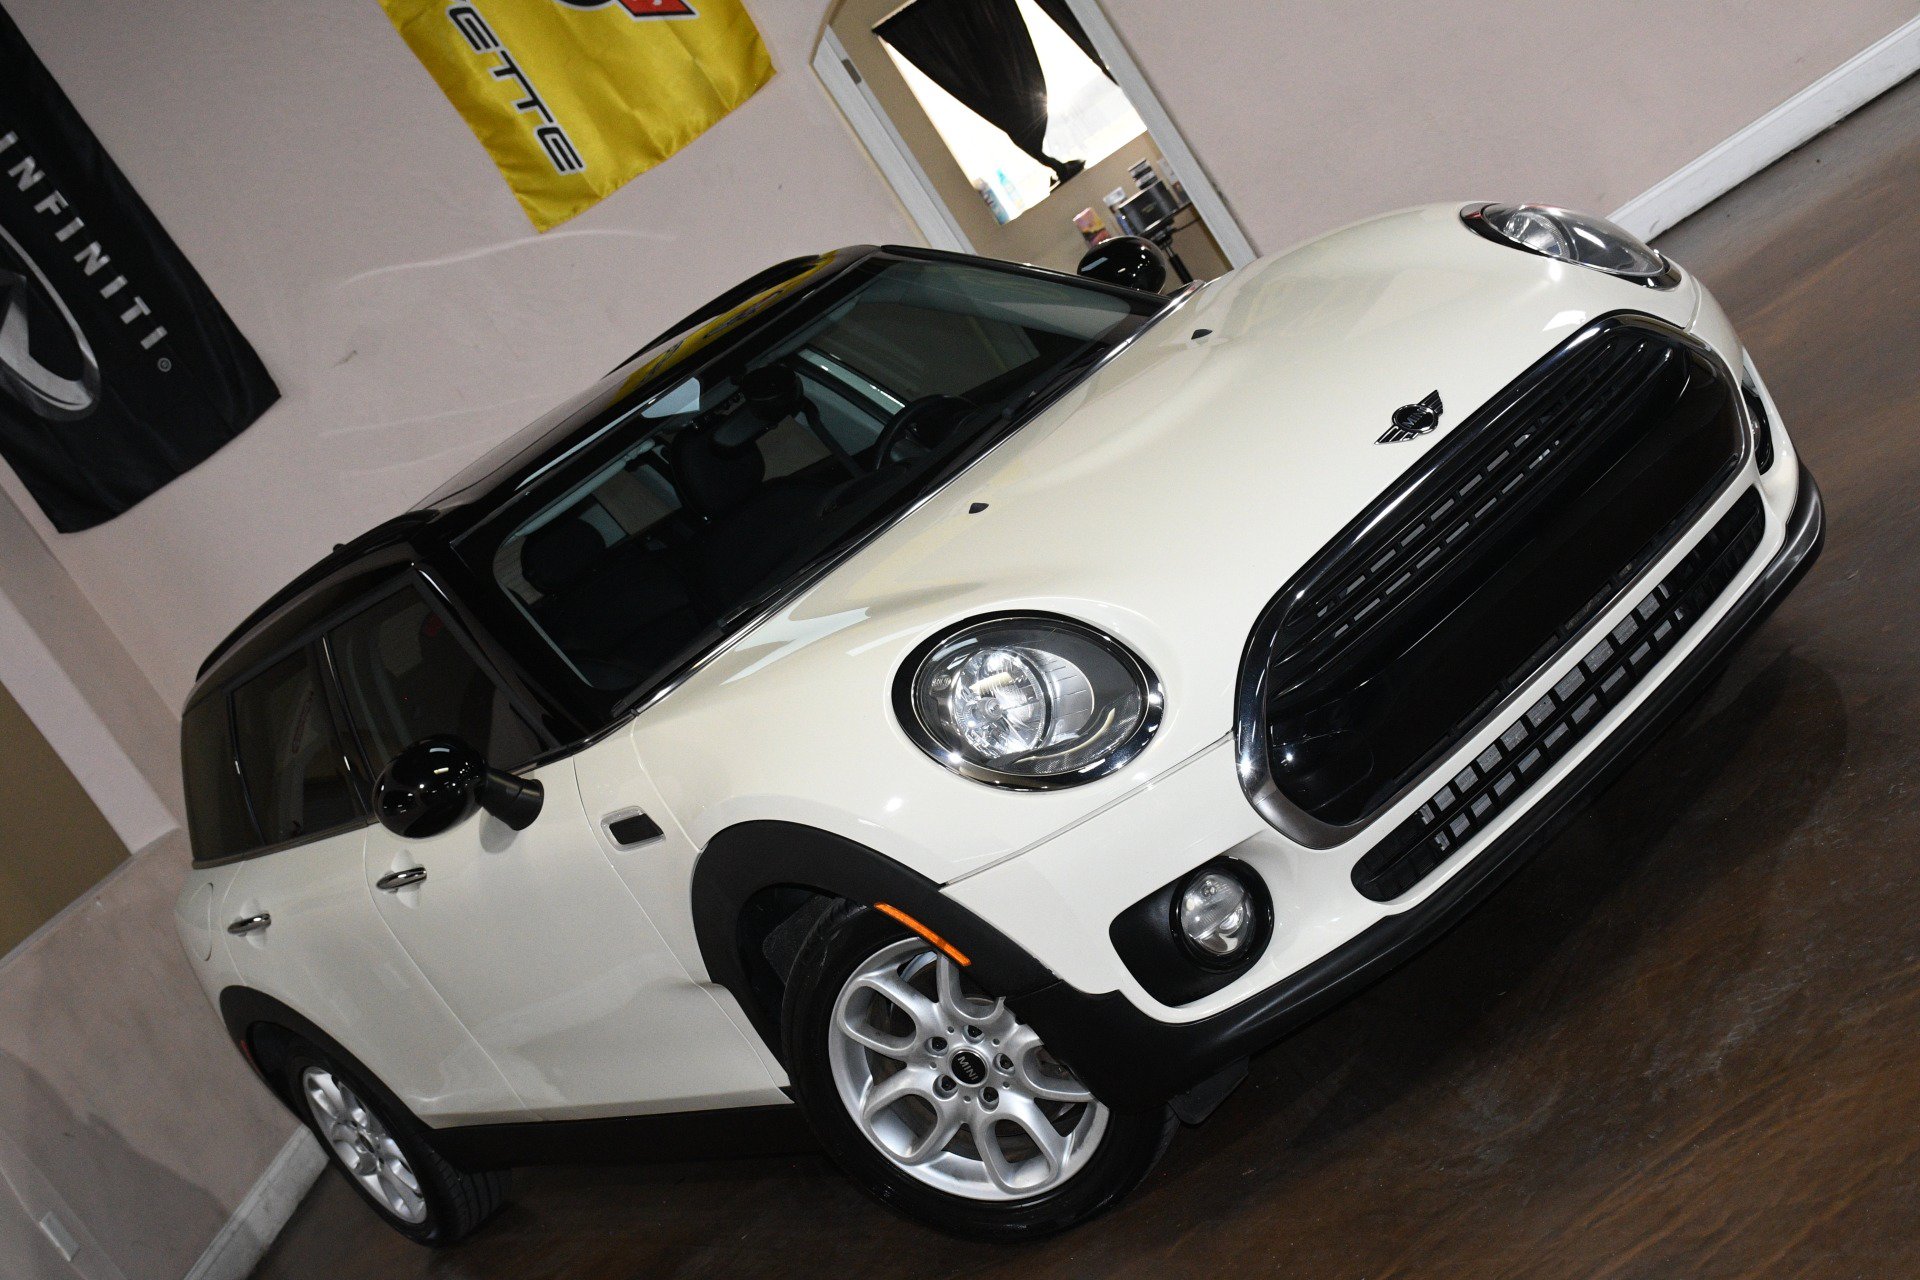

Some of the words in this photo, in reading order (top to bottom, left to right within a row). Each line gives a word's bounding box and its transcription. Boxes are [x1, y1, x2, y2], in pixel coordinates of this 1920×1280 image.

[447, 0, 586, 175] ETTE
[0, 131, 167, 349] INFINITI
[957, 1056, 979, 1080] MINI
